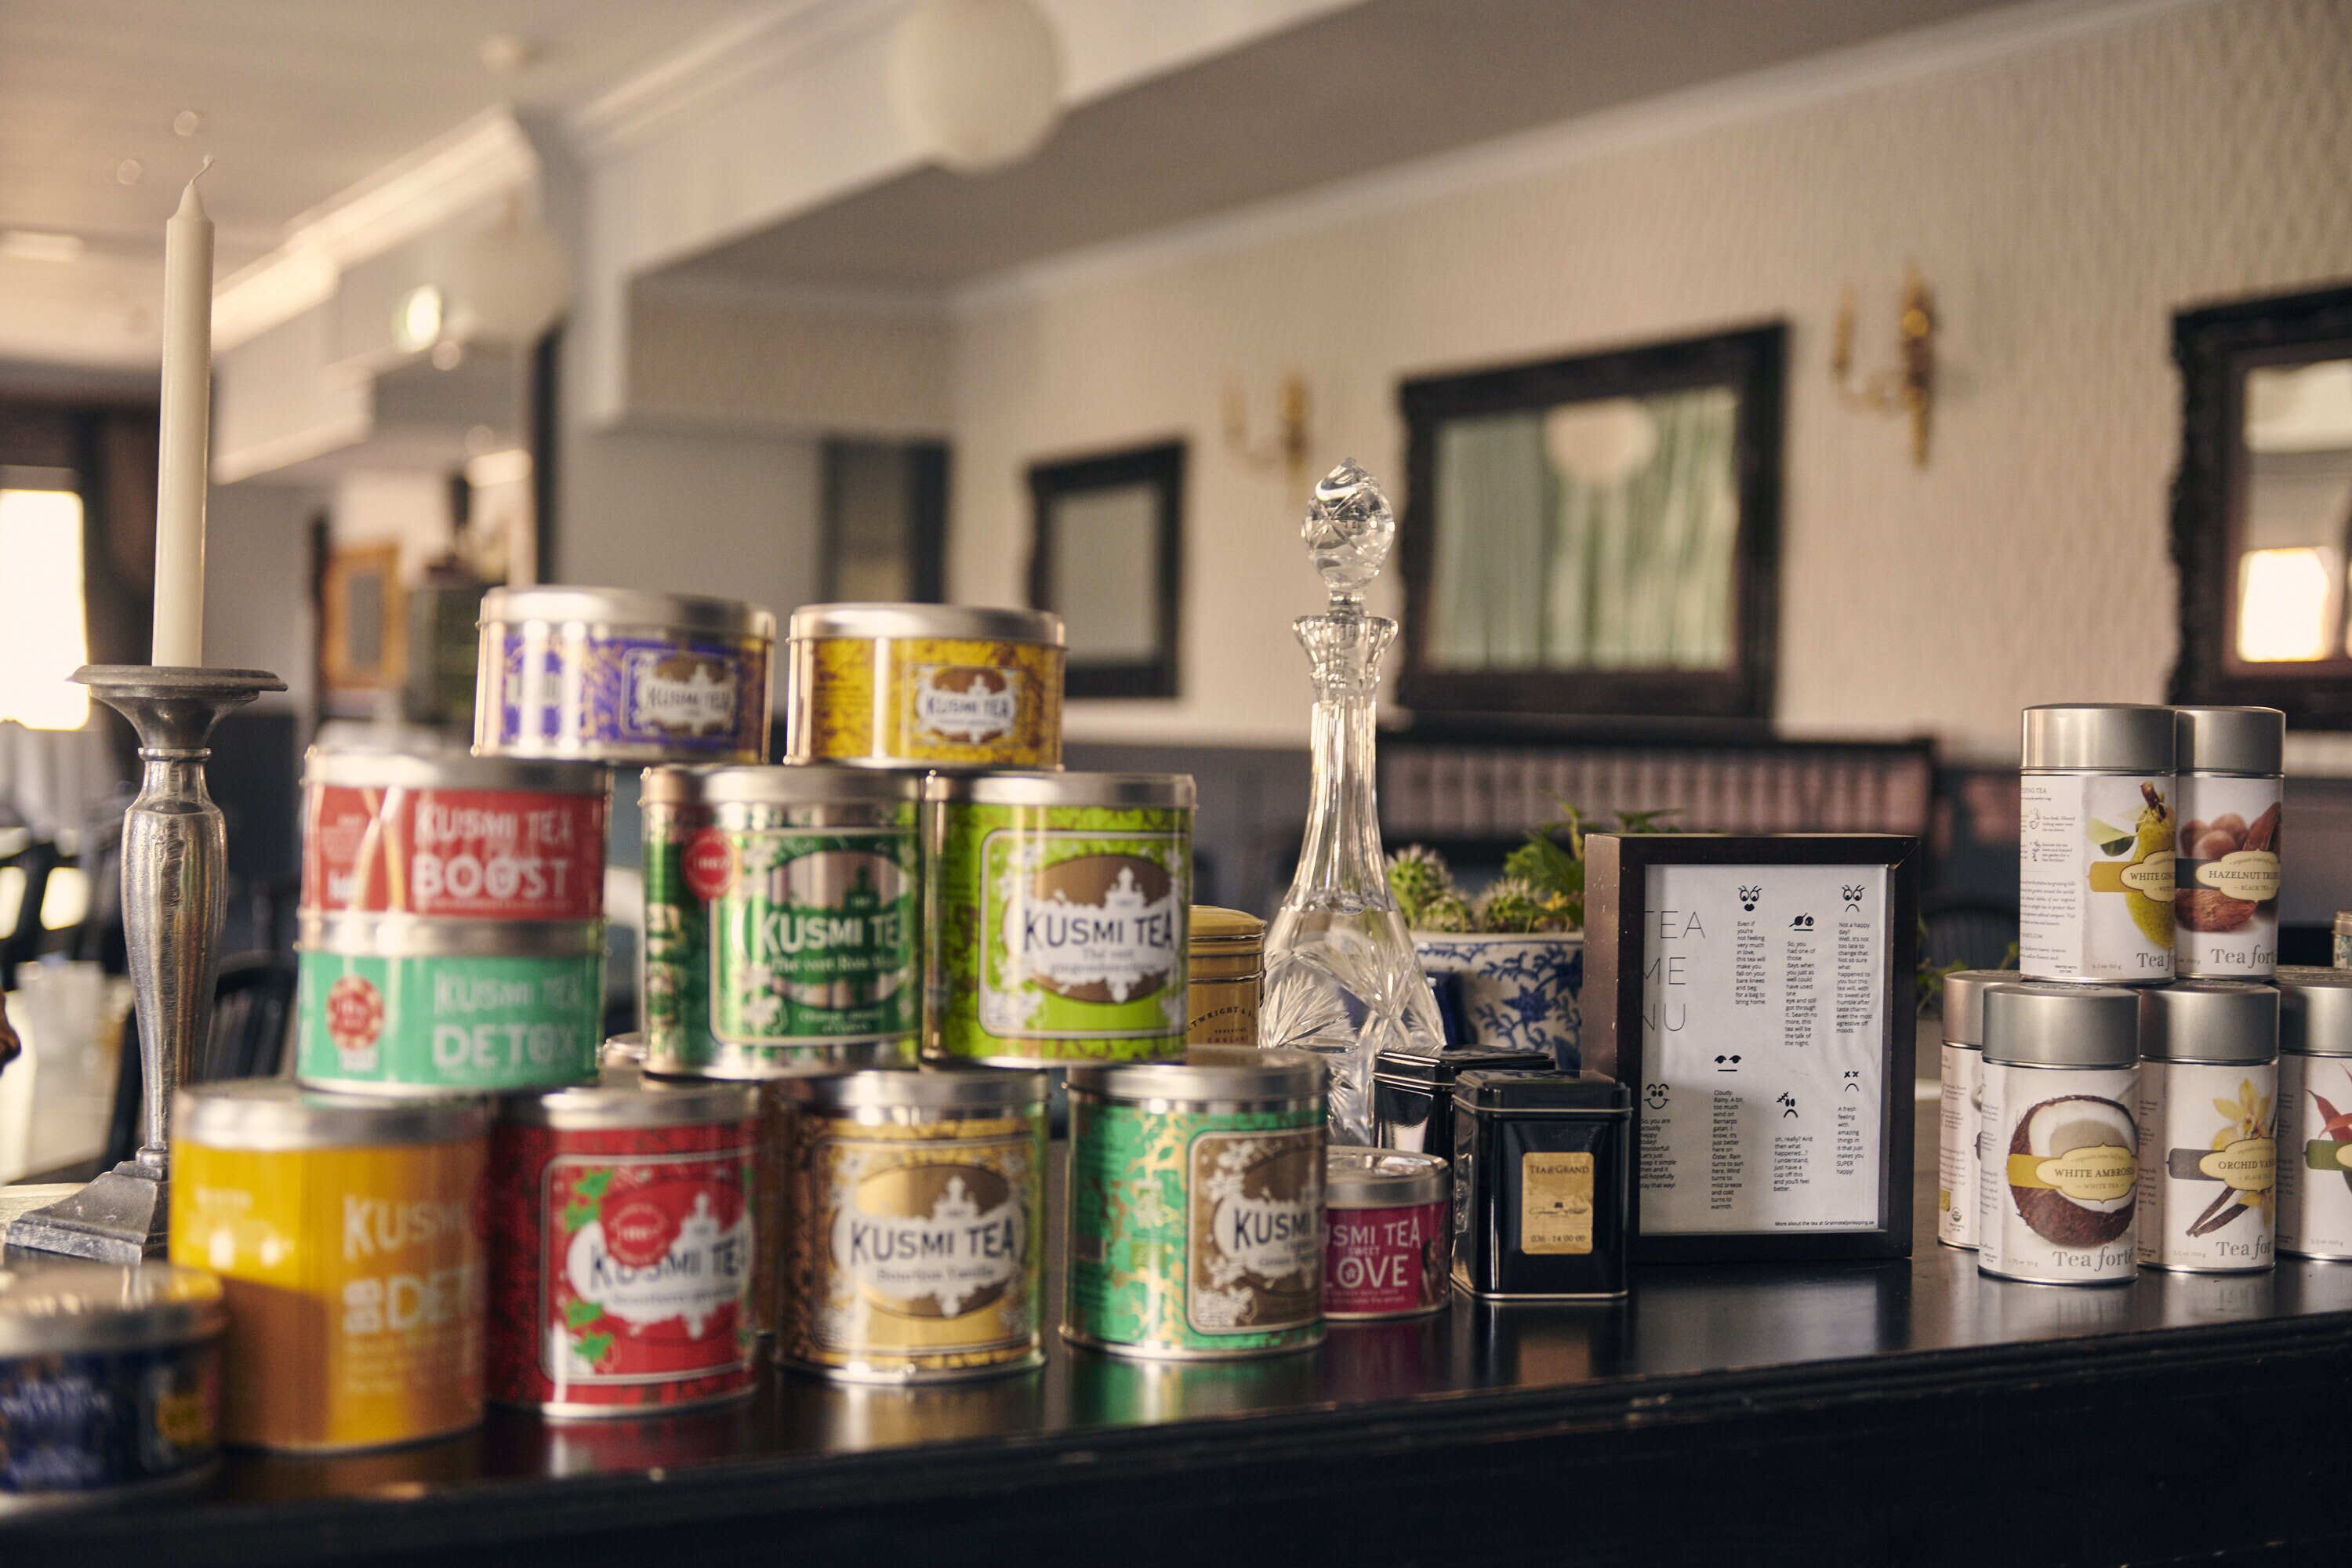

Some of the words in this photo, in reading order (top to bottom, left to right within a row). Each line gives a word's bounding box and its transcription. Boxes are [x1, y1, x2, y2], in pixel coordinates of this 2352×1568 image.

[412, 851, 568, 899] BOOST
[2130, 872, 2160, 880] WHITE
[2209, 870, 2260, 880] HAZELNUT
[762, 912, 862, 954] KUSMI
[870, 914, 908, 950] TE
[1023, 908, 1123, 953] KUSMI
[1134, 908, 1174, 949] TEA
[2136, 952, 2165, 967] Tea
[2209, 948, 2246, 964] Tea
[433, 1024, 576, 1066] DETOX
[1555, 1164, 1590, 1174] GRAND
[2054, 1169, 2092, 1178] WHITE
[851, 1221, 954, 1265] KUSMI
[966, 1217, 1014, 1259] TEA
[1327, 1225, 1376, 1247] SMI
[1384, 1216, 1421, 1250] TEA
[1348, 1246, 1380, 1255] SWEET
[2216, 1241, 2250, 1257] Tea
[2053, 1250, 2092, 1267] Tea
